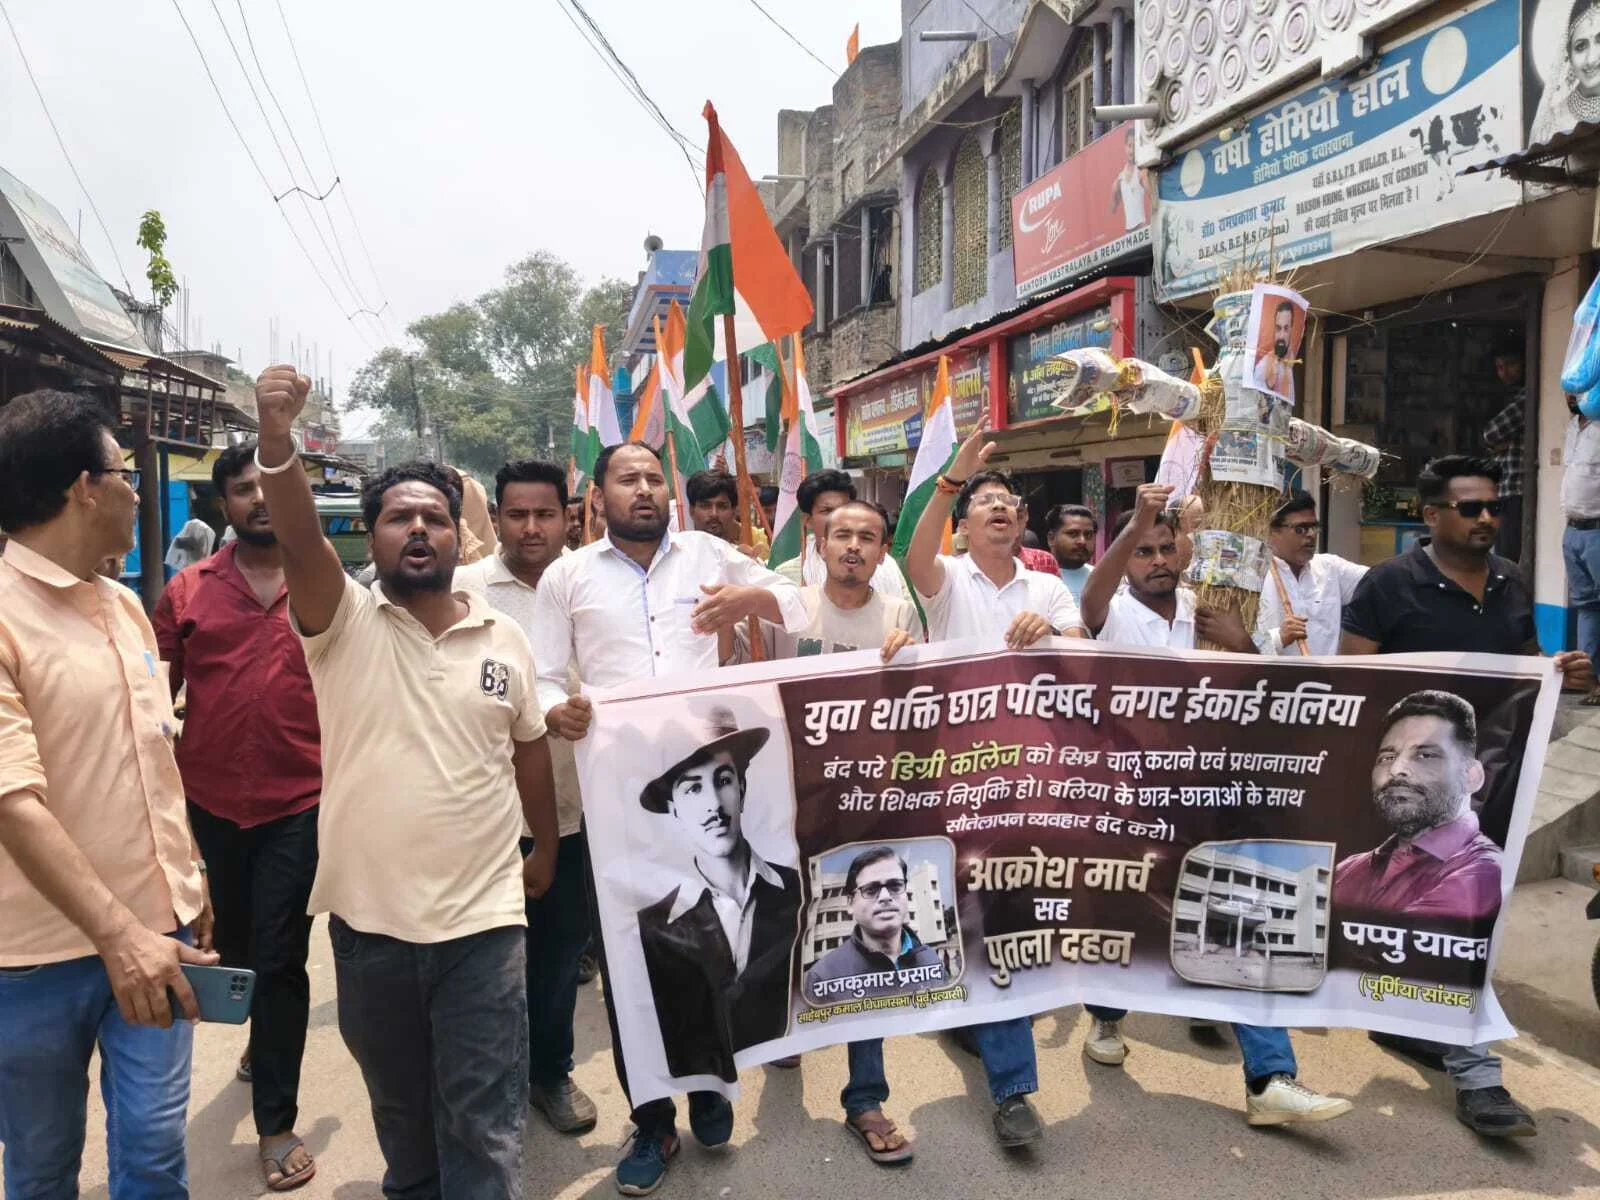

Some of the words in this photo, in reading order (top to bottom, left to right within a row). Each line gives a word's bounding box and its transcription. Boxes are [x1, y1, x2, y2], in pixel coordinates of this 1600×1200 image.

[1212, 122, 1252, 176] वर्षा
[1257, 86, 1342, 157] होमियो
[1348, 58, 1413, 118] हाल
[1028, 182, 1062, 215] RUPA
[1368, 198, 1378, 213] पर
[1019, 276, 1048, 296] SANTOSH
[1049, 256, 1092, 282] VASTRALAYA
[1100, 227, 1150, 259] READYMADE
[804, 698, 866, 746] युवा
[869, 684, 944, 731] शक्ति
[947, 684, 1002, 726] छात्र
[1005, 674, 1100, 724] परिषद,
[1109, 685, 1183, 720] नगर
[1183, 677, 1268, 726] ईकाई
[1269, 681, 1367, 727] बलिया
[823, 754, 855, 779] बंद
[857, 755, 887, 778] परे
[889, 748, 947, 781] डिग्री
[950, 740, 1024, 776] कॉलेज
[1025, 742, 1055, 766] को
[1106, 750, 1144, 778] चालू
[1144, 746, 1199, 771] कराने
[1199, 748, 1228, 771] एवं
[1229, 750, 1328, 776] प्रधानाचार्य
[838, 786, 876, 812] और
[878, 786, 944, 812] शिक्षक
[1014, 774, 1044, 800] हो।
[1046, 778, 1111, 802] बलिया
[1113, 781, 1136, 807] के
[1137, 780, 1244, 807] छात्र-छात्राओं
[1244, 780, 1265, 806] के
[1265, 787, 1306, 807] साथ
[1027, 812, 1093, 829] व्यवहार
[1095, 813, 1126, 834] बंद
[1126, 818, 1176, 842] करो।
[967, 845, 1079, 894] आक्रोश
[1082, 853, 1158, 893] मार्च
[1032, 897, 1073, 922] सह
[983, 928, 1057, 987] पुतला
[1058, 928, 1135, 966] दहन
[1411, 929, 1490, 962] यादव
[813, 971, 896, 998] राजकुमार
[897, 963, 944, 989] प्रसाद
[1359, 972, 1420, 1001] (पूर्णिया
[1420, 983, 1477, 1014] सांसद)
[832, 1003, 863, 1017] कमाल
[862, 996, 911, 1012] विधानसभा
